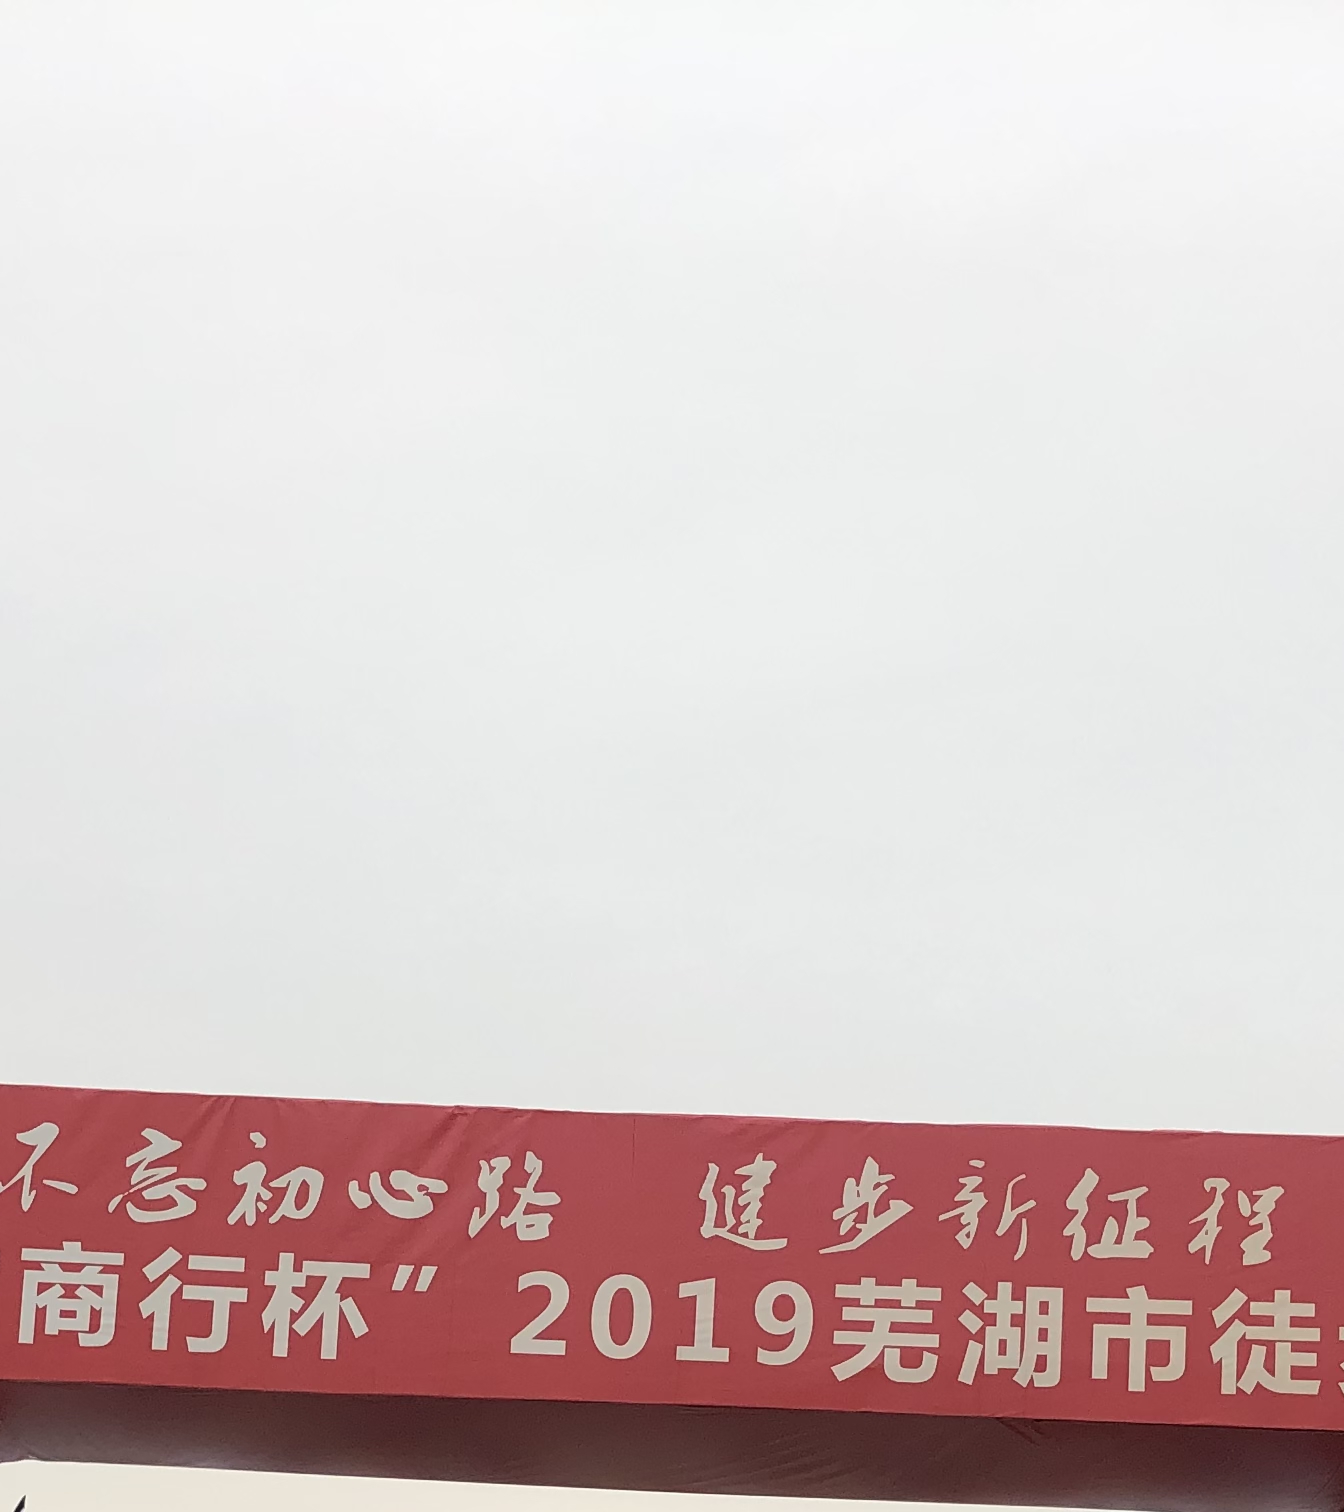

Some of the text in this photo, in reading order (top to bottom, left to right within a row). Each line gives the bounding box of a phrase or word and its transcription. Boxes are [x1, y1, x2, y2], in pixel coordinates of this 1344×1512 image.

[698, 1153, 1283, 1267] 健步新征程
